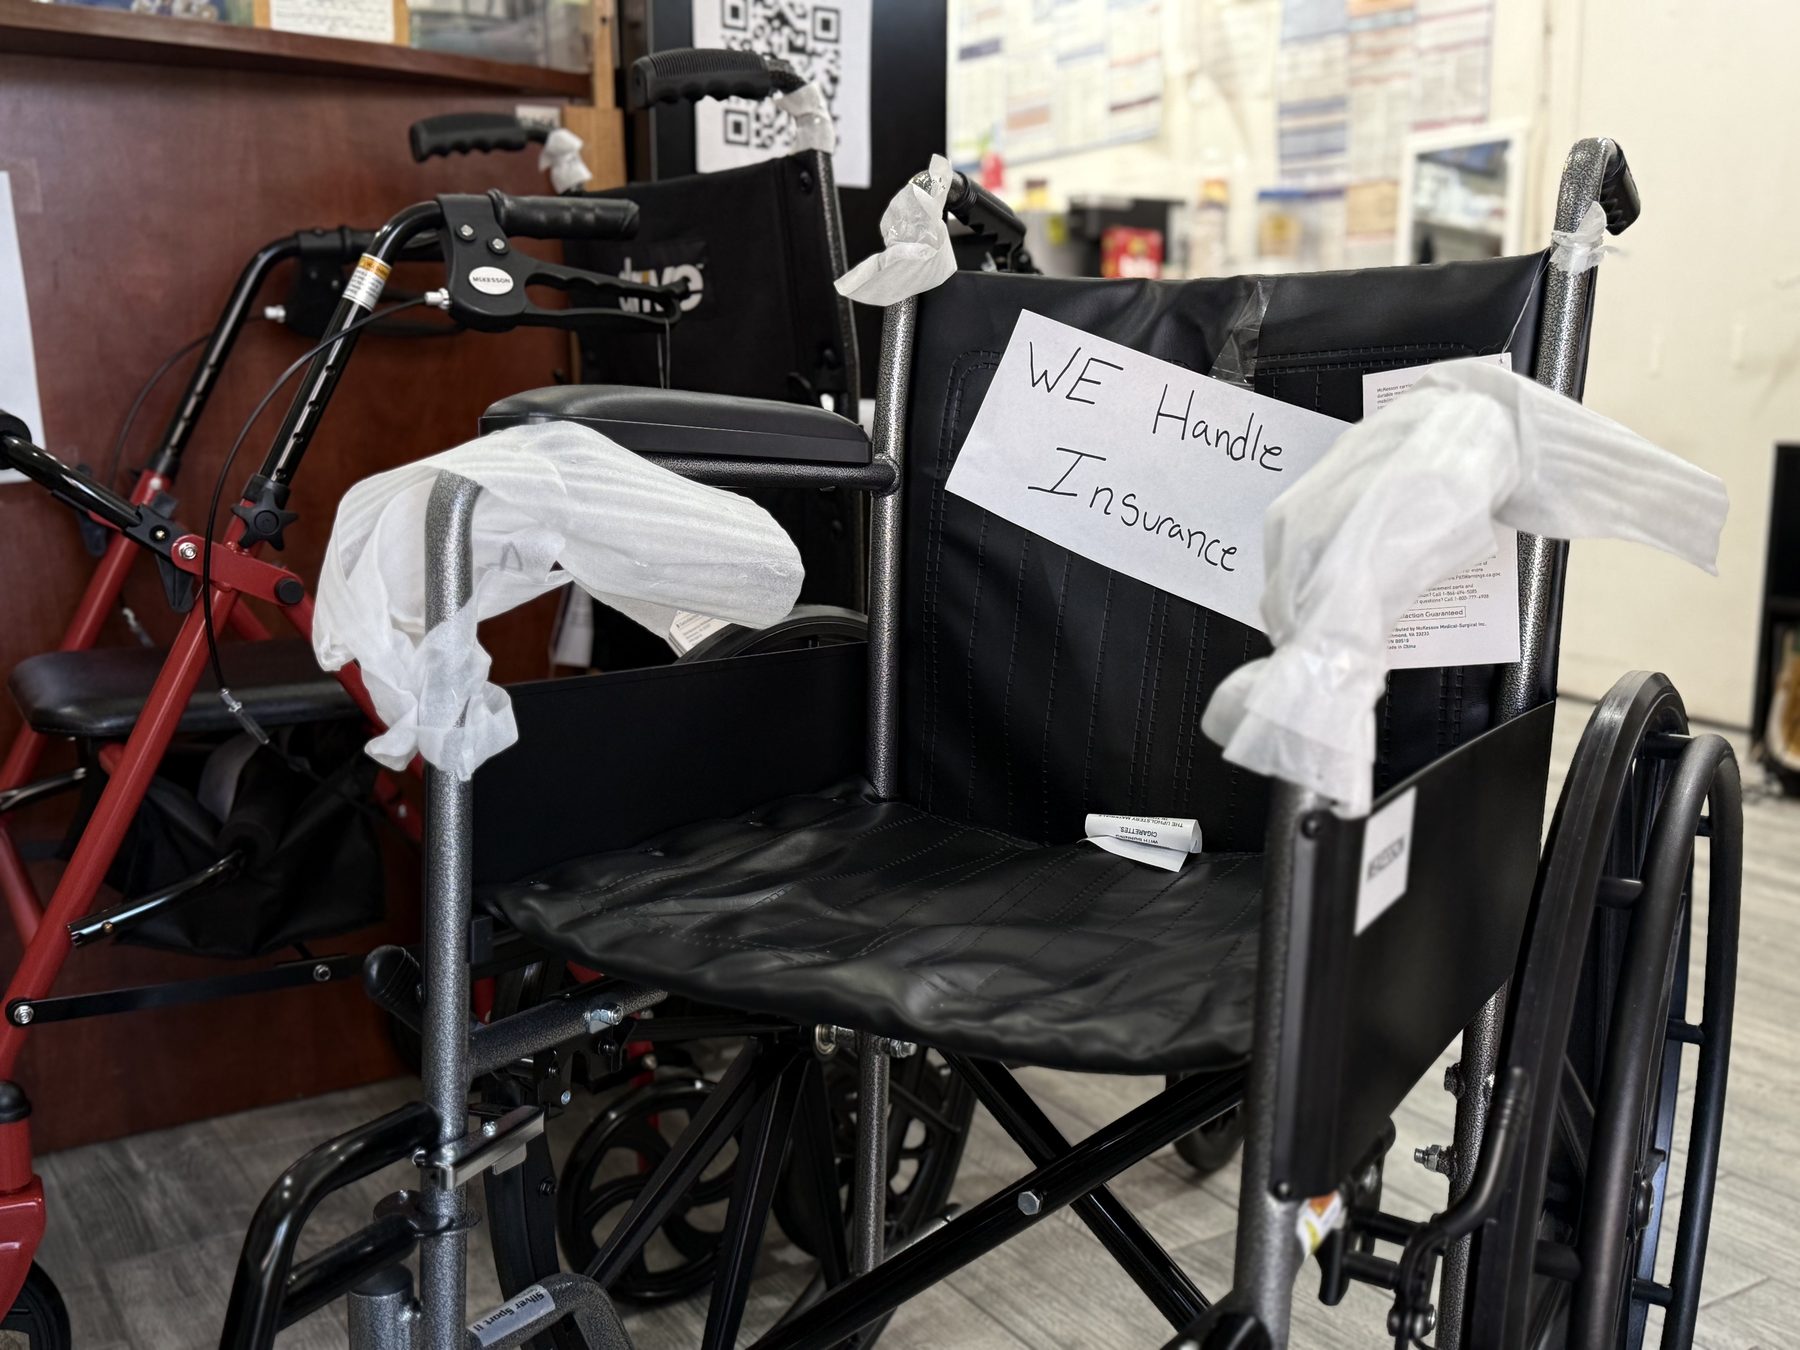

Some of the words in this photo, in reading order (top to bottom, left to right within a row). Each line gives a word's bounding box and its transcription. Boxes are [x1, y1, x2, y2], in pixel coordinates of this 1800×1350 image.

[1029, 341, 1124, 405] WE
[1152, 383, 1284, 472] Handle
[1027, 446, 1238, 572] Insurance
[1425, 609, 1464, 618] Guaranteed
[1120, 826, 1158, 837] CIGARETTES.
[515, 1291, 545, 1309] Silver
[483, 1307, 515, 1326] Sport
